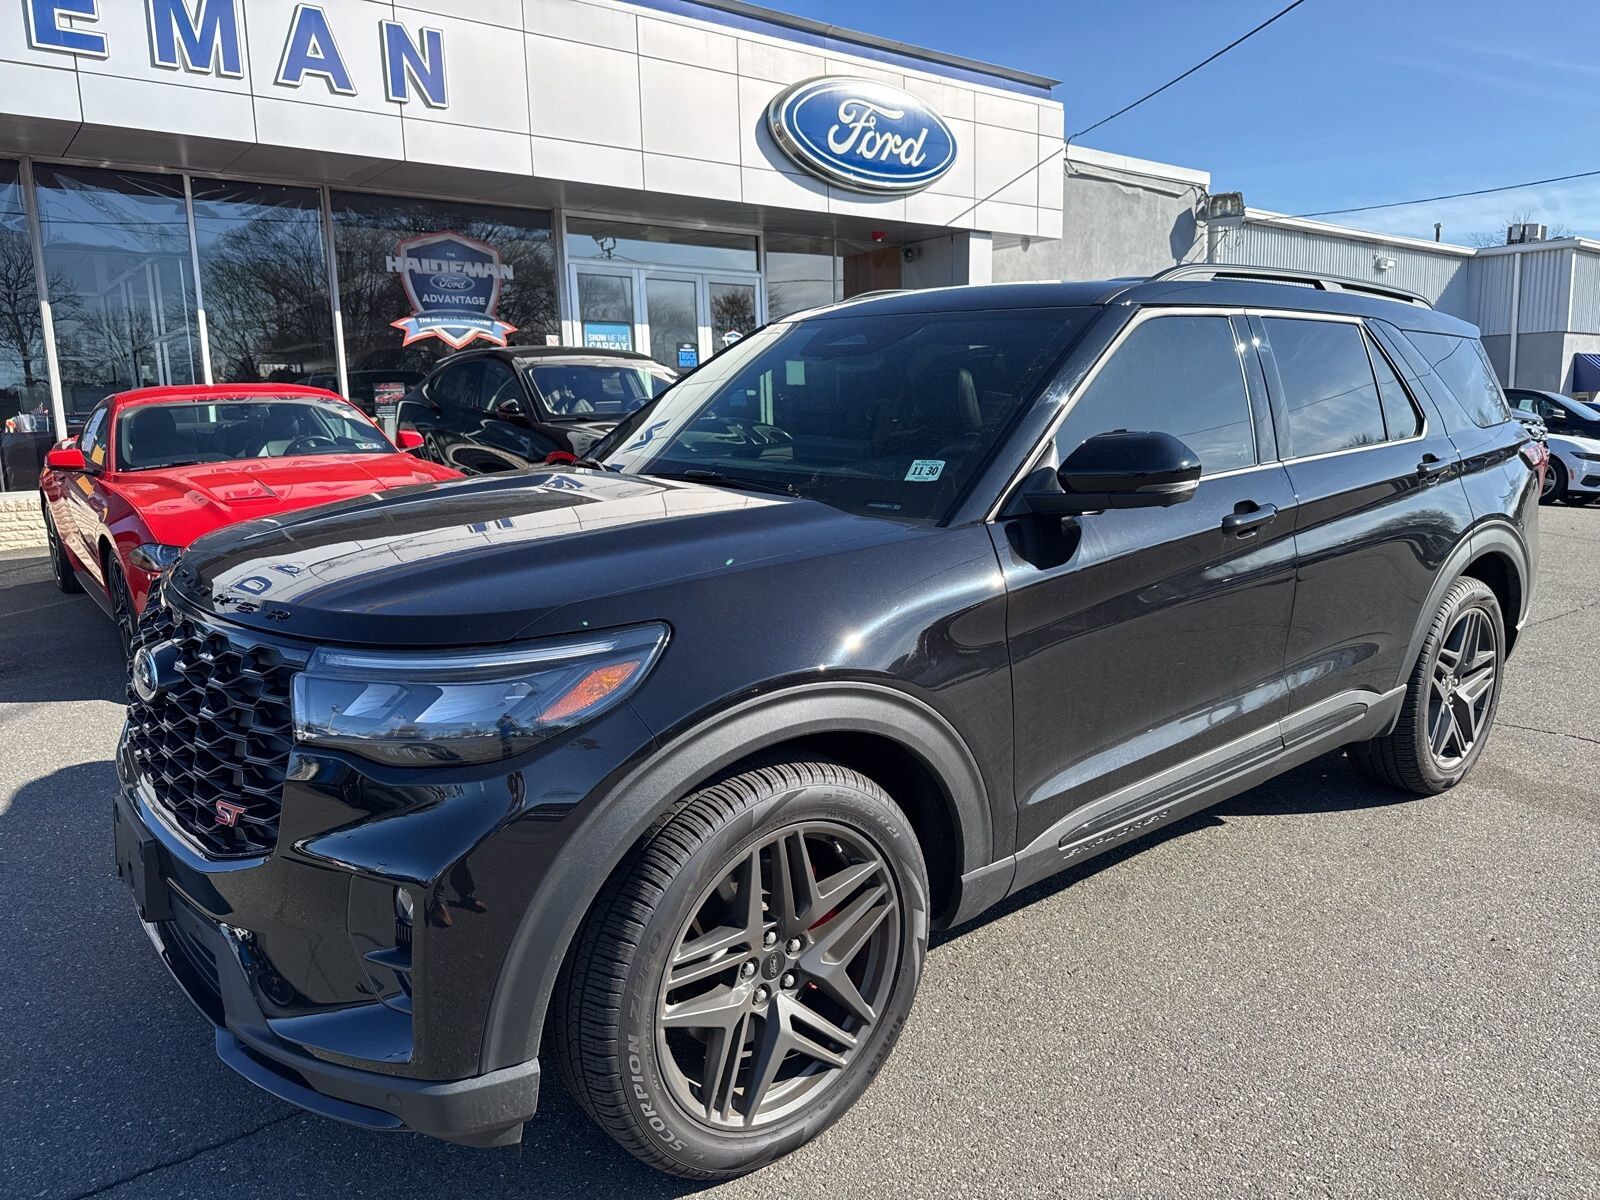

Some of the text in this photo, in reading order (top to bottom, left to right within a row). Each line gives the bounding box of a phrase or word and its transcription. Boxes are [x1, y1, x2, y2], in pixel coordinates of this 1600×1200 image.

[23, 0, 449, 109] EMAN
[828, 98, 929, 168] Ford
[385, 255, 515, 280] HALDEMAN
[439, 276, 466, 289] Ford
[422, 293, 486, 306] ADVANTAGE
[588, 333, 607, 342] SHOW
[678, 351, 697, 360] TRUCK
[911, 466, 939, 476] 11 30
[215, 799, 247, 828] ST
[627, 1034, 689, 1152] SCORPION
